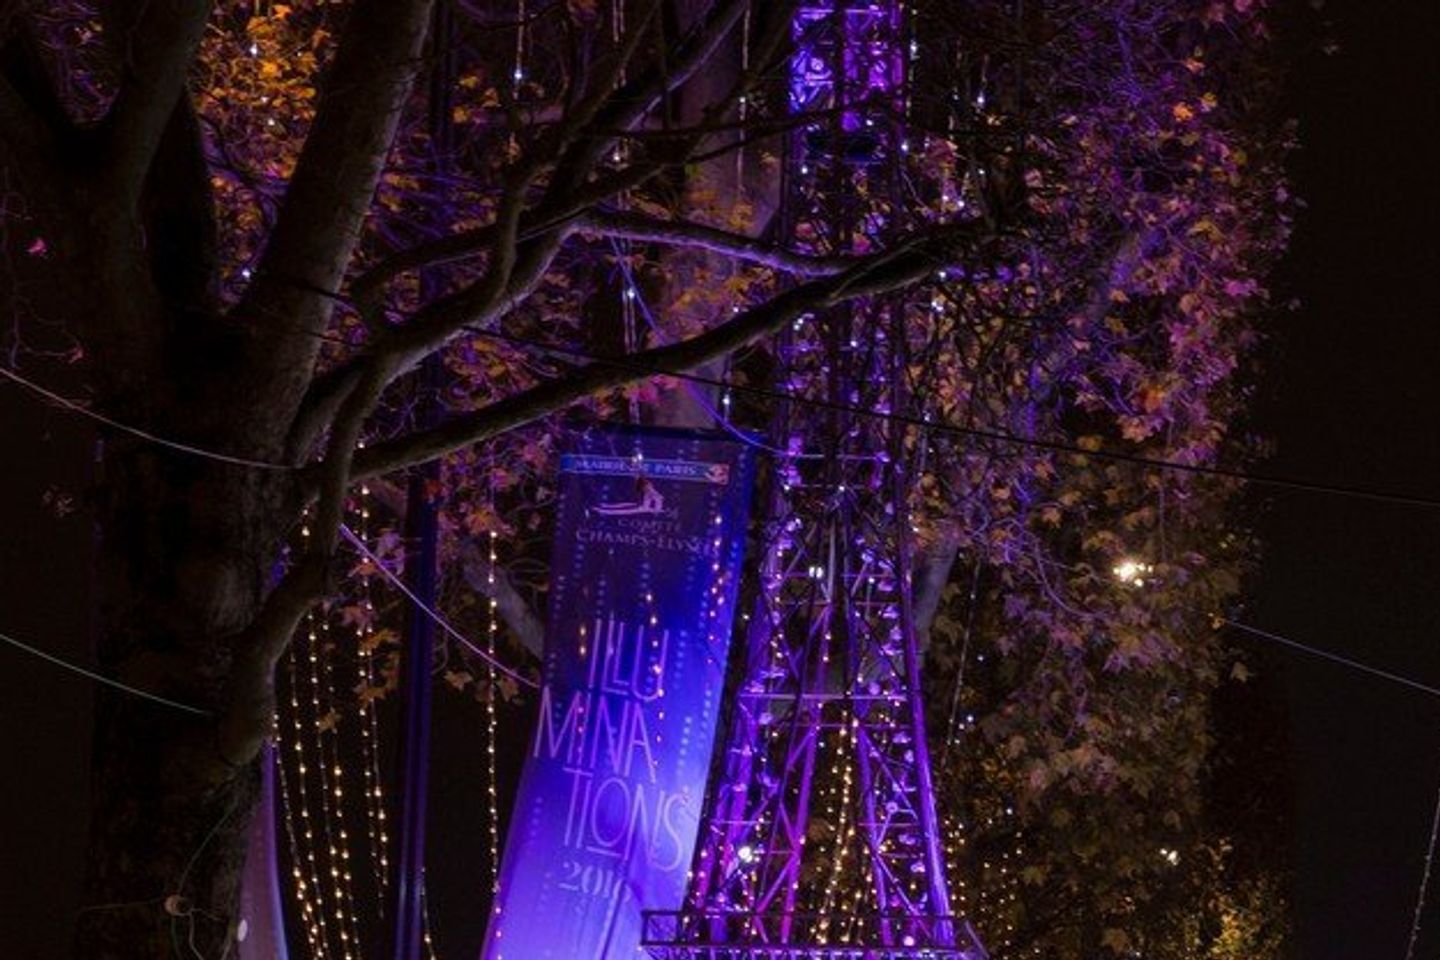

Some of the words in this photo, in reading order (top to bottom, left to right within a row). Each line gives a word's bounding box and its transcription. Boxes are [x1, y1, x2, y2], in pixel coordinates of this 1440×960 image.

[654, 462, 697, 475] PARIS
[588, 616, 670, 701] ILLU
[533, 684, 656, 784] MINA
[562, 765, 692, 872] TIONS
